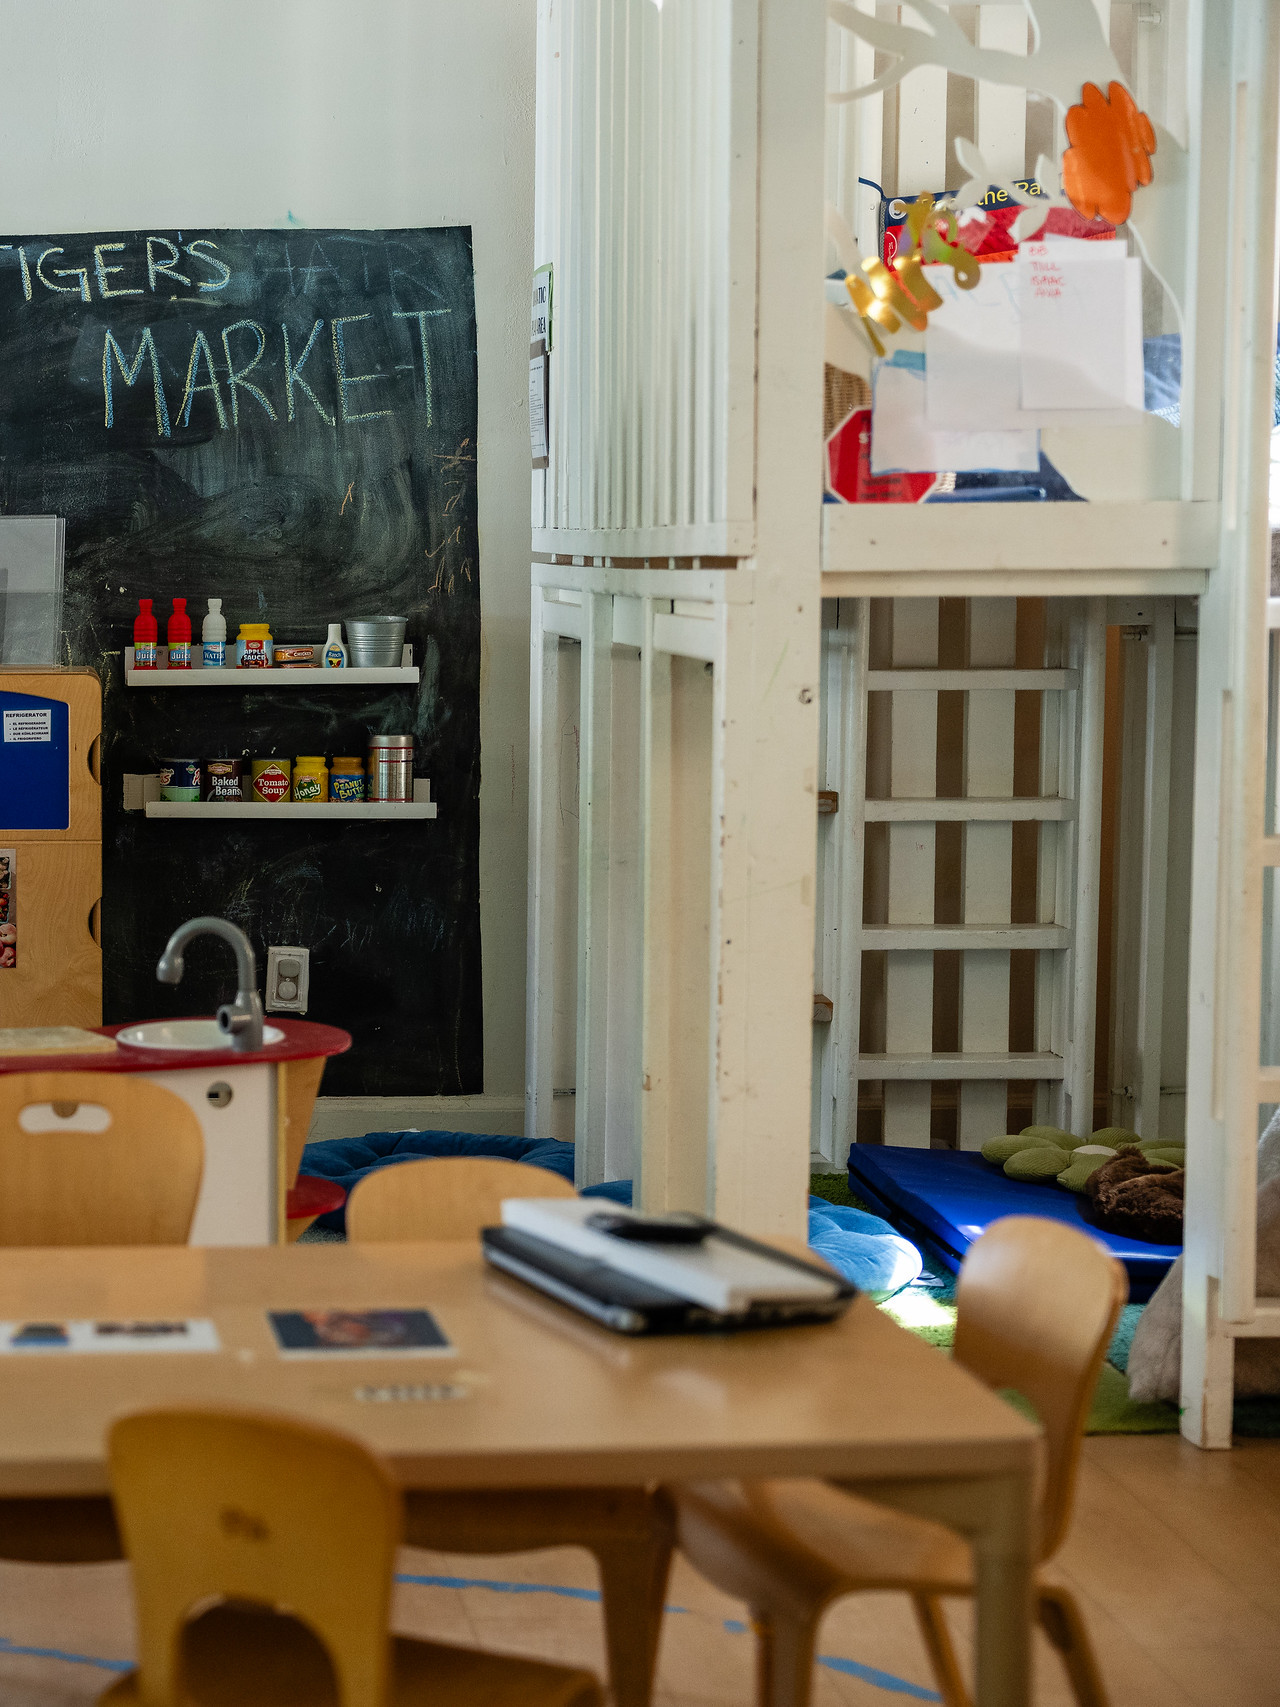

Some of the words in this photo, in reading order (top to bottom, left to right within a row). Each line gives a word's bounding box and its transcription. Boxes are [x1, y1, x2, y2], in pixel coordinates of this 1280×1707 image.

[101, 309, 452, 437] MARKET
[212, 777, 238, 786] Baked
[334, 779, 362, 793] PEANUT
[216, 787, 241, 795] Beans
[262, 787, 284, 795] Soup
[294, 783, 320, 799] Honey
